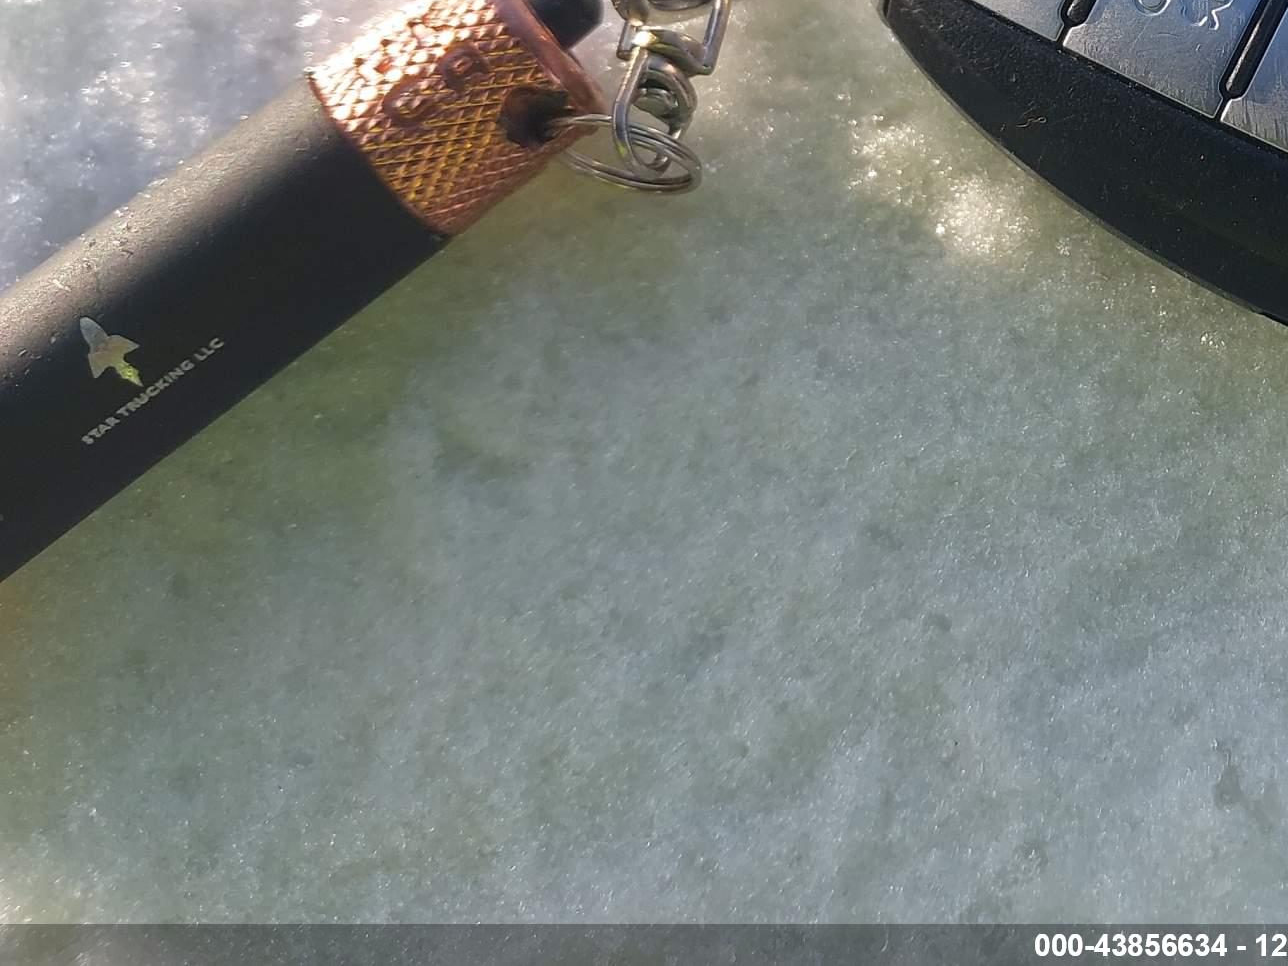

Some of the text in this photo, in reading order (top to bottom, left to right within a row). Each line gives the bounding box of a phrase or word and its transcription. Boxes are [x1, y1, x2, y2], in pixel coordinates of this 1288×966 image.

[82, 337, 224, 444] STAR TRUCKING LLC
